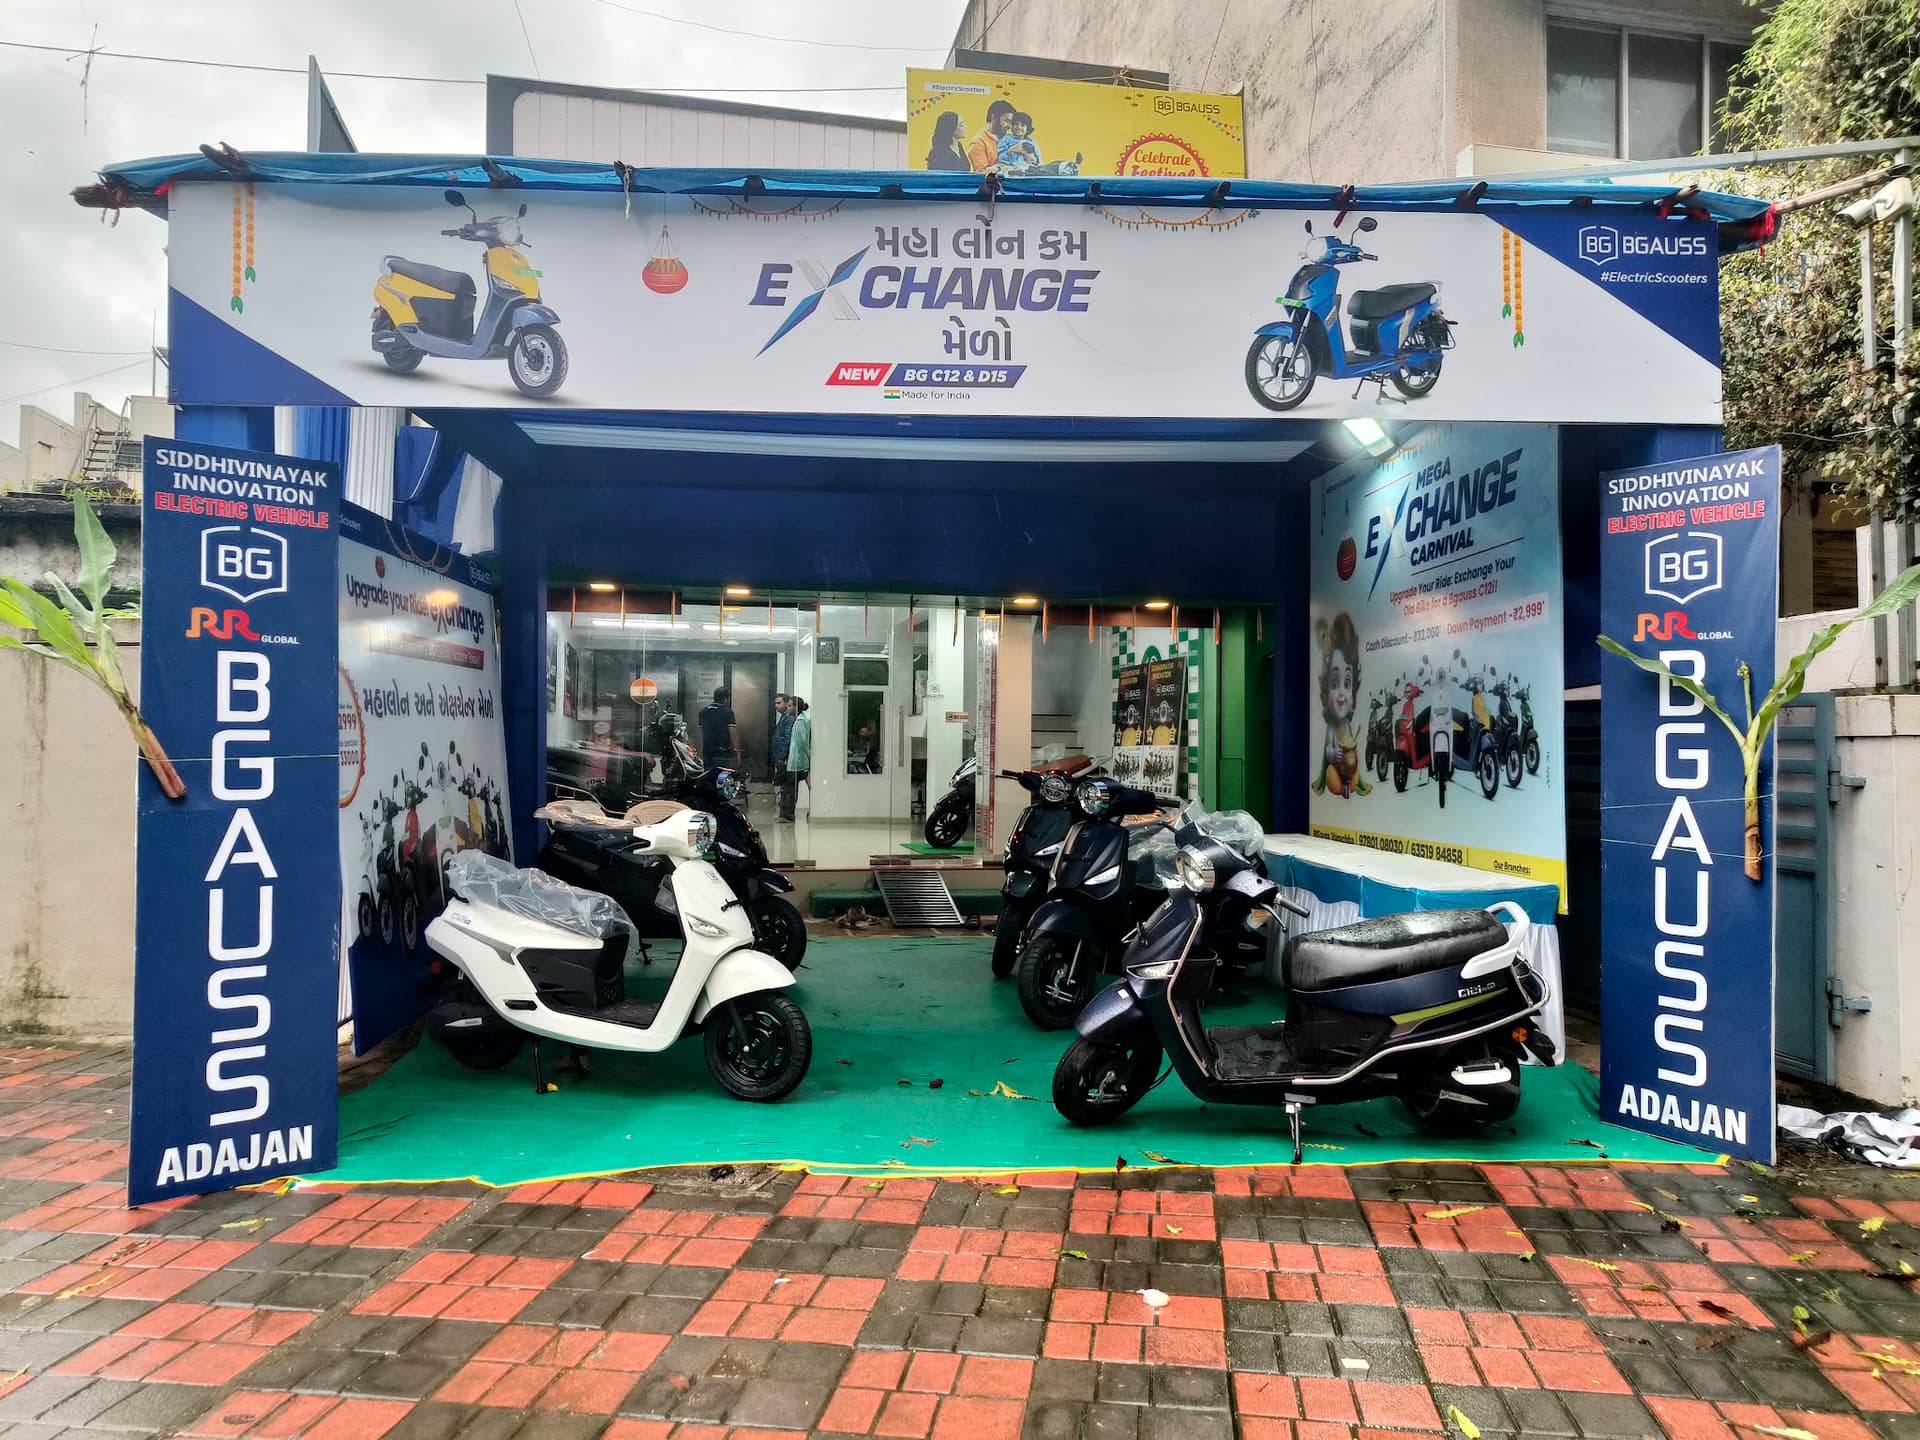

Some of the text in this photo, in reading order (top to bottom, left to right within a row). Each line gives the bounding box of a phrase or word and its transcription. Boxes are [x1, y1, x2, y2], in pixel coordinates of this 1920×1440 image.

[931, 84, 986, 94] #ElectricScooters
[1176, 101, 1220, 114] BGAUSS
[1134, 149, 1191, 166] Celebrate
[875, 214, 1087, 261] મહા લોન કમ
[1622, 236, 1707, 255] BGAUSS
[1600, 271, 1708, 284] #ElectricScooters
[942, 316, 1012, 361] મેળો
[838, 368, 1007, 383] NEW BG C12 & D15
[902, 390, 971, 400] Made for India
[156, 448, 328, 488] SIDDHIVINAYAK
[1416, 456, 1451, 491] MEGA
[1608, 459, 1765, 495] SIDDHIVINAYAK
[173, 472, 314, 506] INNOVATION
[1621, 481, 1750, 512] INNOVATION
[155, 491, 329, 529] ELECTRIC VEHICLE
[1364, 447, 1524, 600] EXCHANGE
[1607, 500, 1766, 534] ELECTRIC VEHICLE
[1410, 527, 1475, 567] CARNIVAL
[346, 573, 389, 609] Upgrade
[389, 590, 409, 616] your
[1389, 585, 1418, 607] Upgrade
[1418, 579, 1435, 594] Your
[1454, 563, 1493, 584] Exchange
[1495, 556, 1516, 573] Your
[185, 607, 300, 645] RR GLOBAL
[1447, 621, 1469, 635] Down
[1469, 611, 1507, 633] Payment
[1633, 610, 1734, 642] RR GLOBAL
[1365, 641, 1381, 652] Cash
[1381, 634, 1409, 649] Discount
[414, 682, 436, 717] અને
[1435, 845, 1464, 865] 84858
[1493, 859, 1503, 869] Our
[204, 649, 279, 1127] BGAUSS
[1618, 1083, 1747, 1145] ADAJAN
[156, 1124, 313, 1186] ADAJAN
